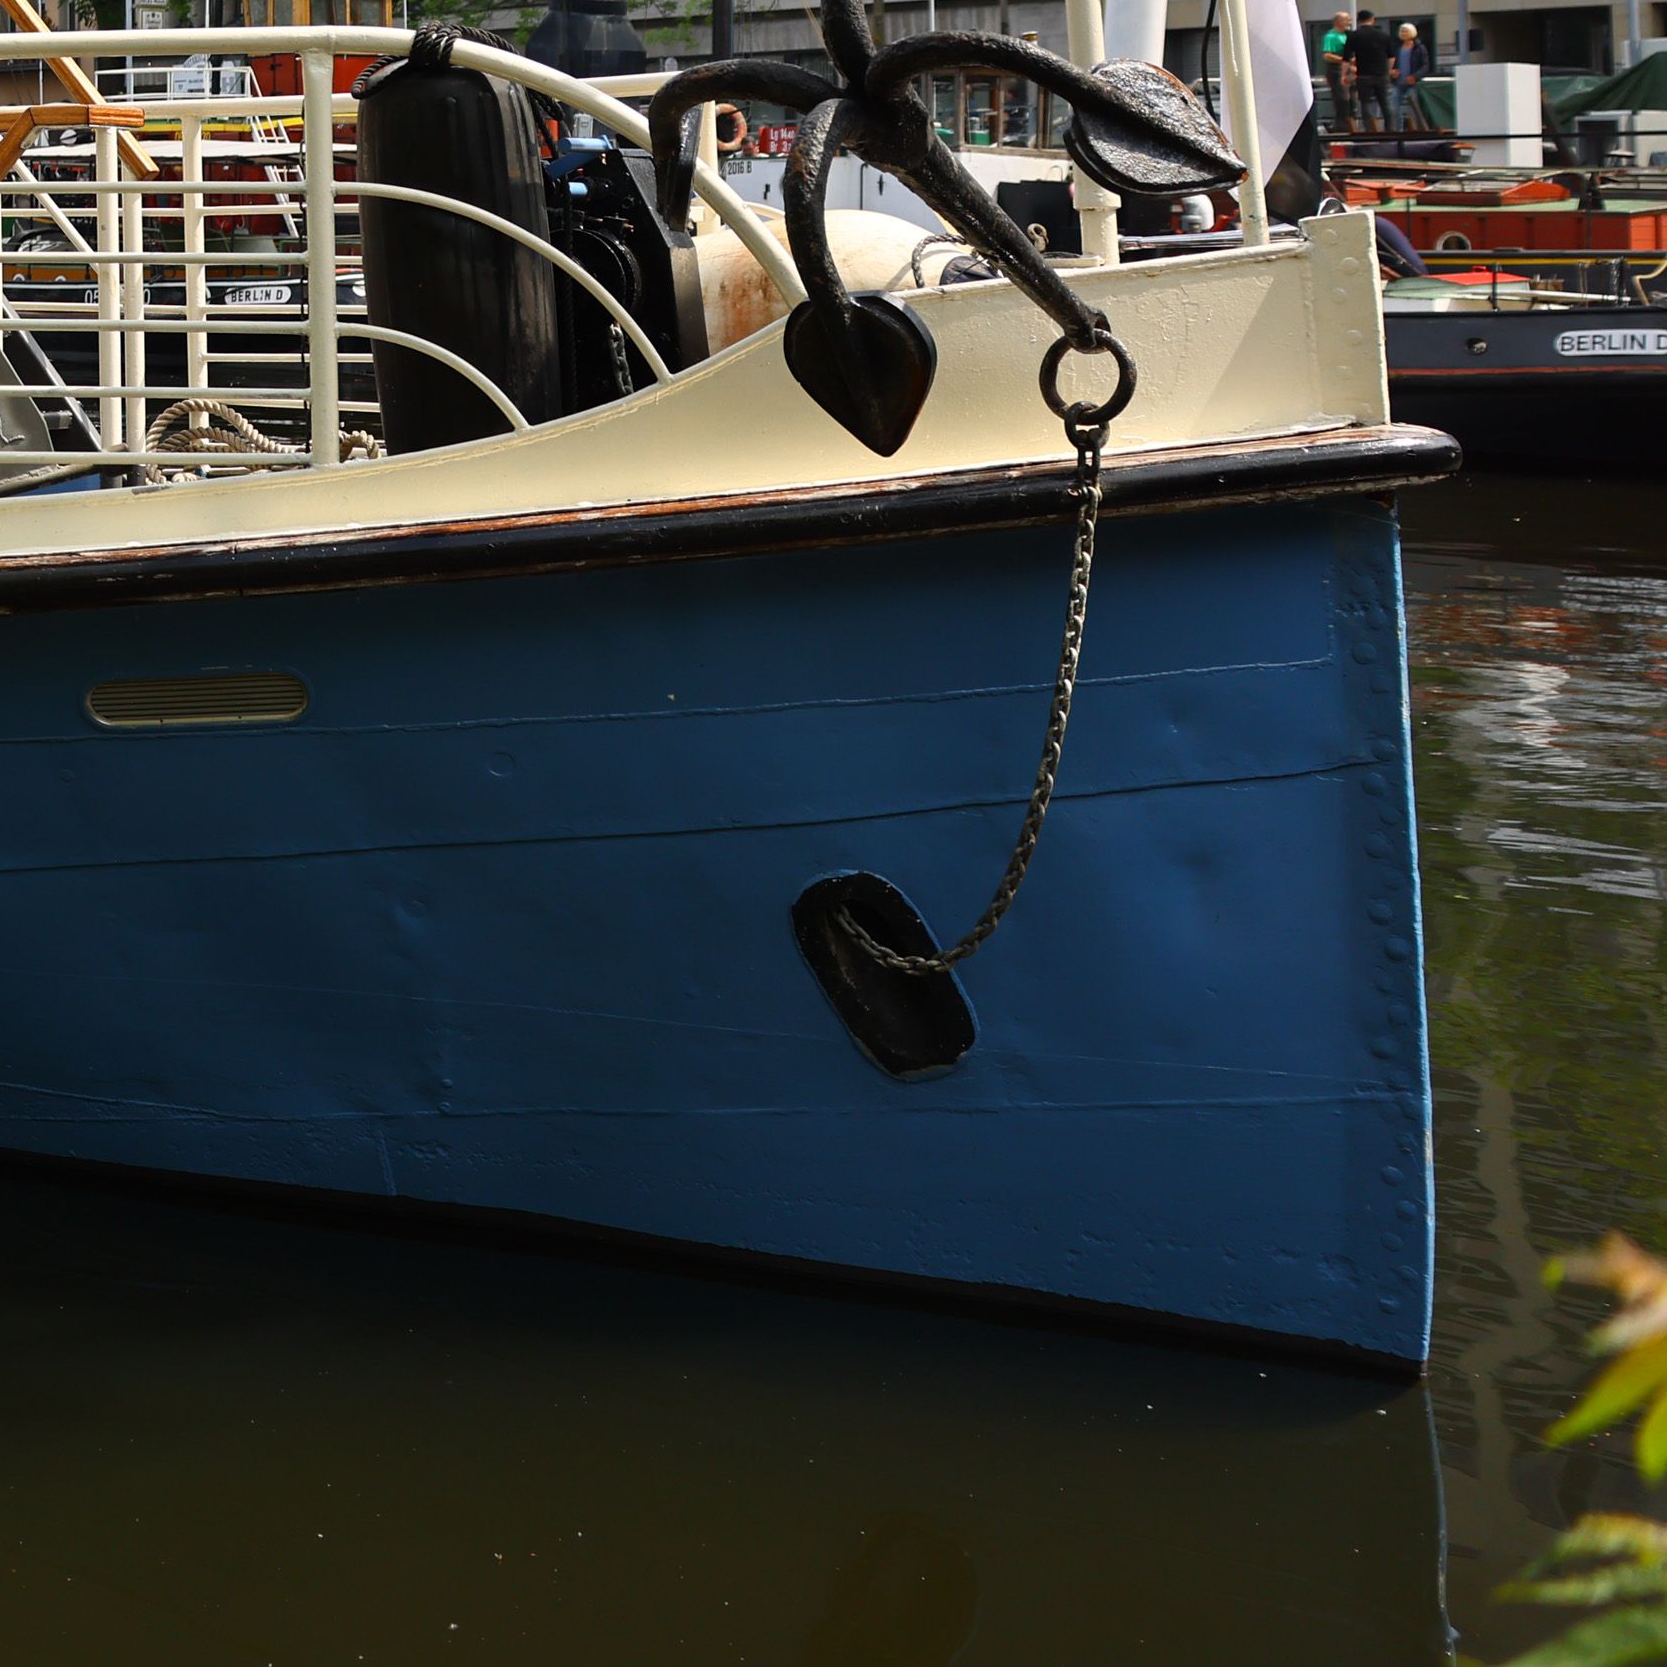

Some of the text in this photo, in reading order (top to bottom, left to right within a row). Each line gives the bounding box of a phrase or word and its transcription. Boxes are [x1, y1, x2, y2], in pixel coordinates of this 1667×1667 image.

[231, 287, 283, 303] BERLIN D
[1560, 334, 1647, 352] BERLIN
